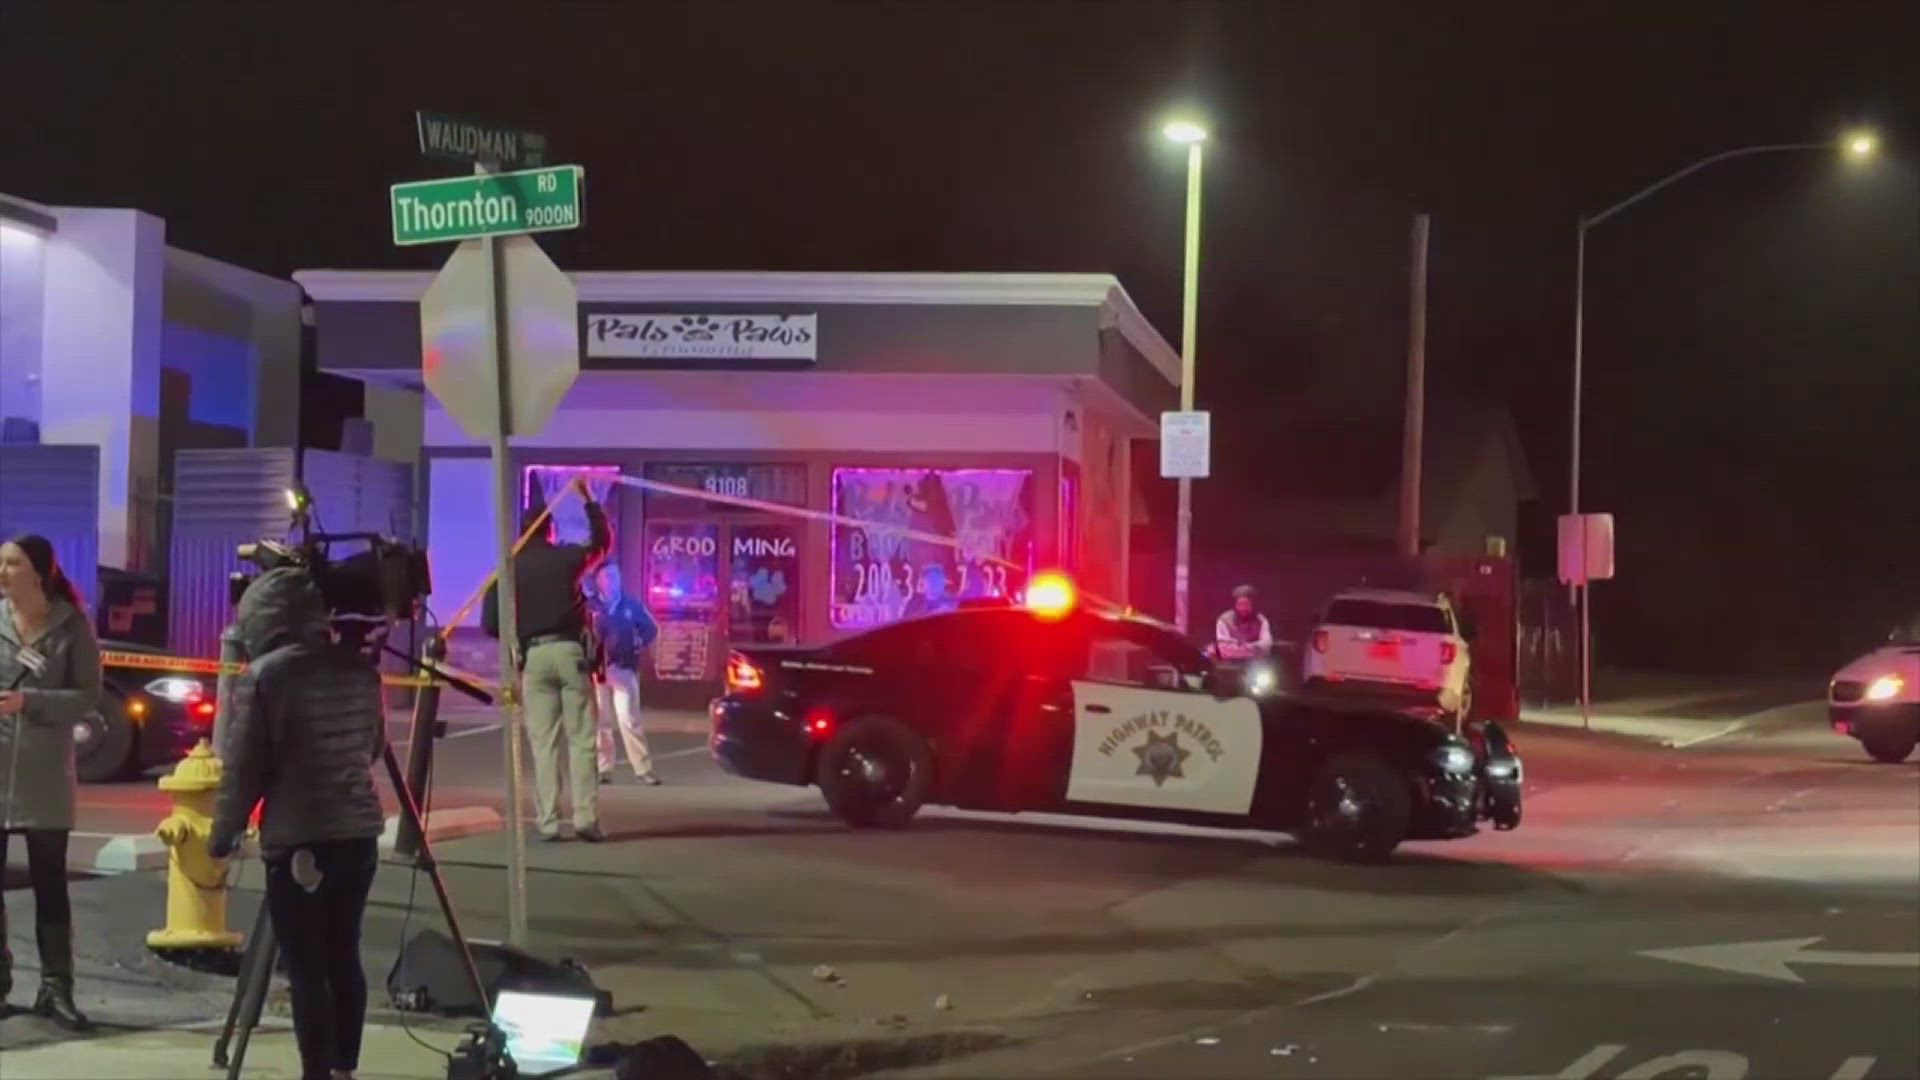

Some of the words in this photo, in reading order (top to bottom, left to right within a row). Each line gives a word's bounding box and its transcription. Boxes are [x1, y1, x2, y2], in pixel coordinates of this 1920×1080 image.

[426, 119, 518, 162] WAUDMAN
[536, 172, 558, 193] RD
[398, 190, 517, 232] Thornton
[525, 204, 573, 226] 9000N
[588, 318, 669, 343] Pals
[725, 318, 812, 346] Paws
[733, 537, 796, 557] MING
[1098, 711, 1170, 758] HIGHWAY
[1173, 713, 1225, 763] PATROL
